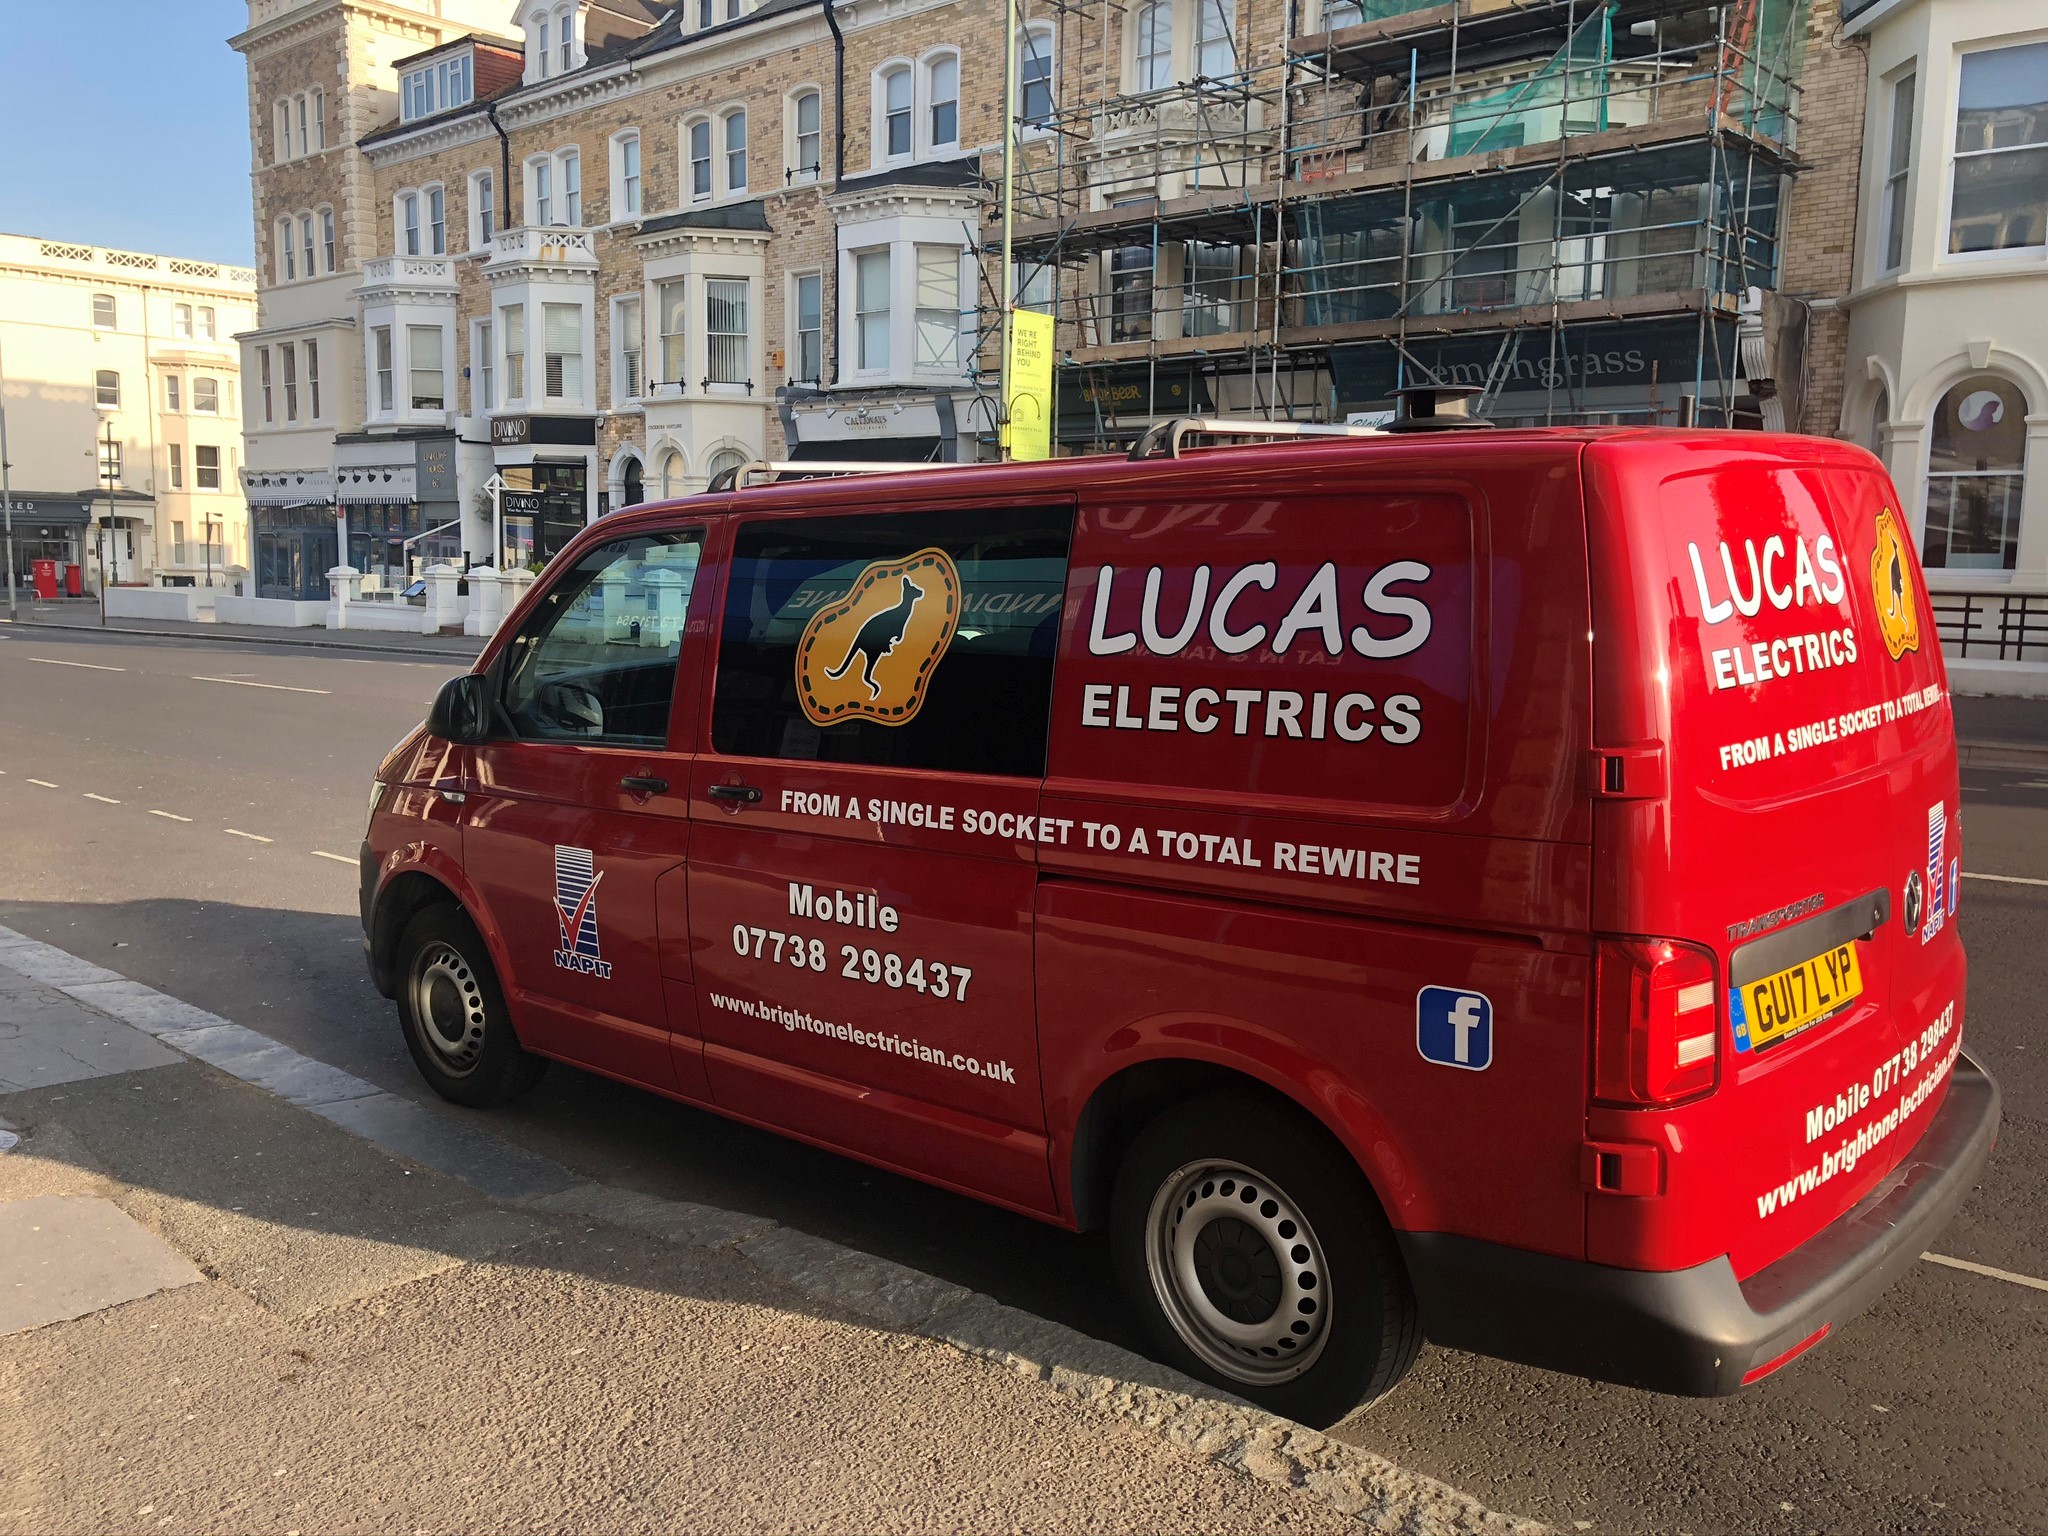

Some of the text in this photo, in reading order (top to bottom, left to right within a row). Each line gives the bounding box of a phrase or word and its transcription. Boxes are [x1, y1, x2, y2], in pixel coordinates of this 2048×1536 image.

[1017, 329, 1037, 339] WE'RE
[1017, 339, 1037, 348] RIGHT
[1017, 348, 1041, 359] BEHIND
[1016, 358, 1031, 367] YOU
[494, 420, 526, 437] DIVINO
[505, 496, 540, 509] DIVINO
[1688, 534, 1845, 625] LUCAS
[1089, 561, 1431, 658] LUCAS
[1711, 627, 1857, 690] ELECTRICS
[1081, 684, 1422, 744] ELECTRICS
[1719, 736, 1770, 770] FROM
[1774, 733, 1786, 757] A
[1788, 717, 1838, 752] SINGLE
[1839, 705, 1882, 737] SOCKET
[1883, 701, 1896, 723] TO
[1897, 698, 1903, 719] A
[1902, 690, 1925, 716] TOTAL
[781, 790, 1421, 885] FROM A SINGLE SOCKET TO A TOTAL REWIRE
[789, 882, 899, 933] Mobile
[1726, 893, 1825, 942] TRANSPORTER
[1922, 908, 1946, 946] NAPIT
[554, 949, 613, 980] NAPIT
[732, 923, 973, 1002] 07738 298437
[1753, 946, 1851, 1033] GU17 LYP
[709, 992, 1016, 1085] www.brightonelectrician.co.uk
[1447, 996, 1482, 1064] f
[1735, 1023, 1747, 1039] GB
[1806, 999, 1954, 1144] Mobile 07738 298437
